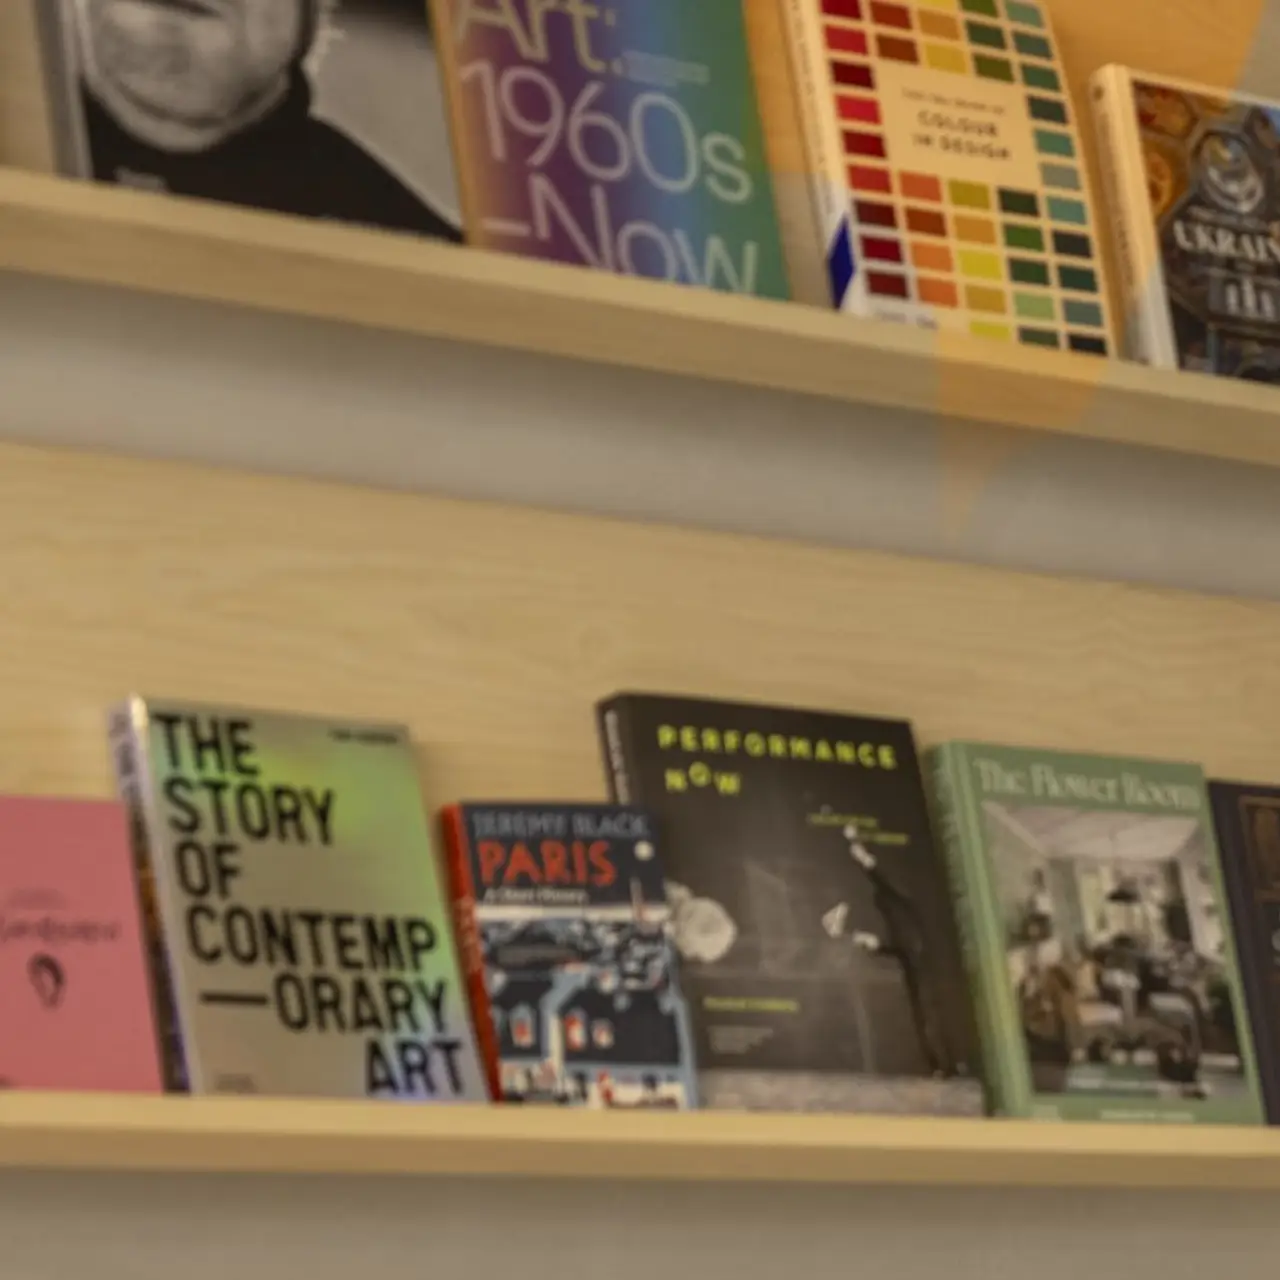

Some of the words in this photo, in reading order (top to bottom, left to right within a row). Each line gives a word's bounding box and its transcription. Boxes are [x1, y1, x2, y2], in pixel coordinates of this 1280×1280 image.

[458, 60, 752, 202] 1960s
[153, 712, 258, 779] THE
[656, 723, 898, 771] PERFORMANCE
[663, 760, 743, 797] NOW
[163, 776, 335, 846] STORY
[571, 811, 651, 839] BLACK
[175, 839, 241, 901] OF
[478, 838, 619, 889] PARIS
[186, 904, 438, 974] CONTEMP
[365, 1038, 465, 1099] ART
